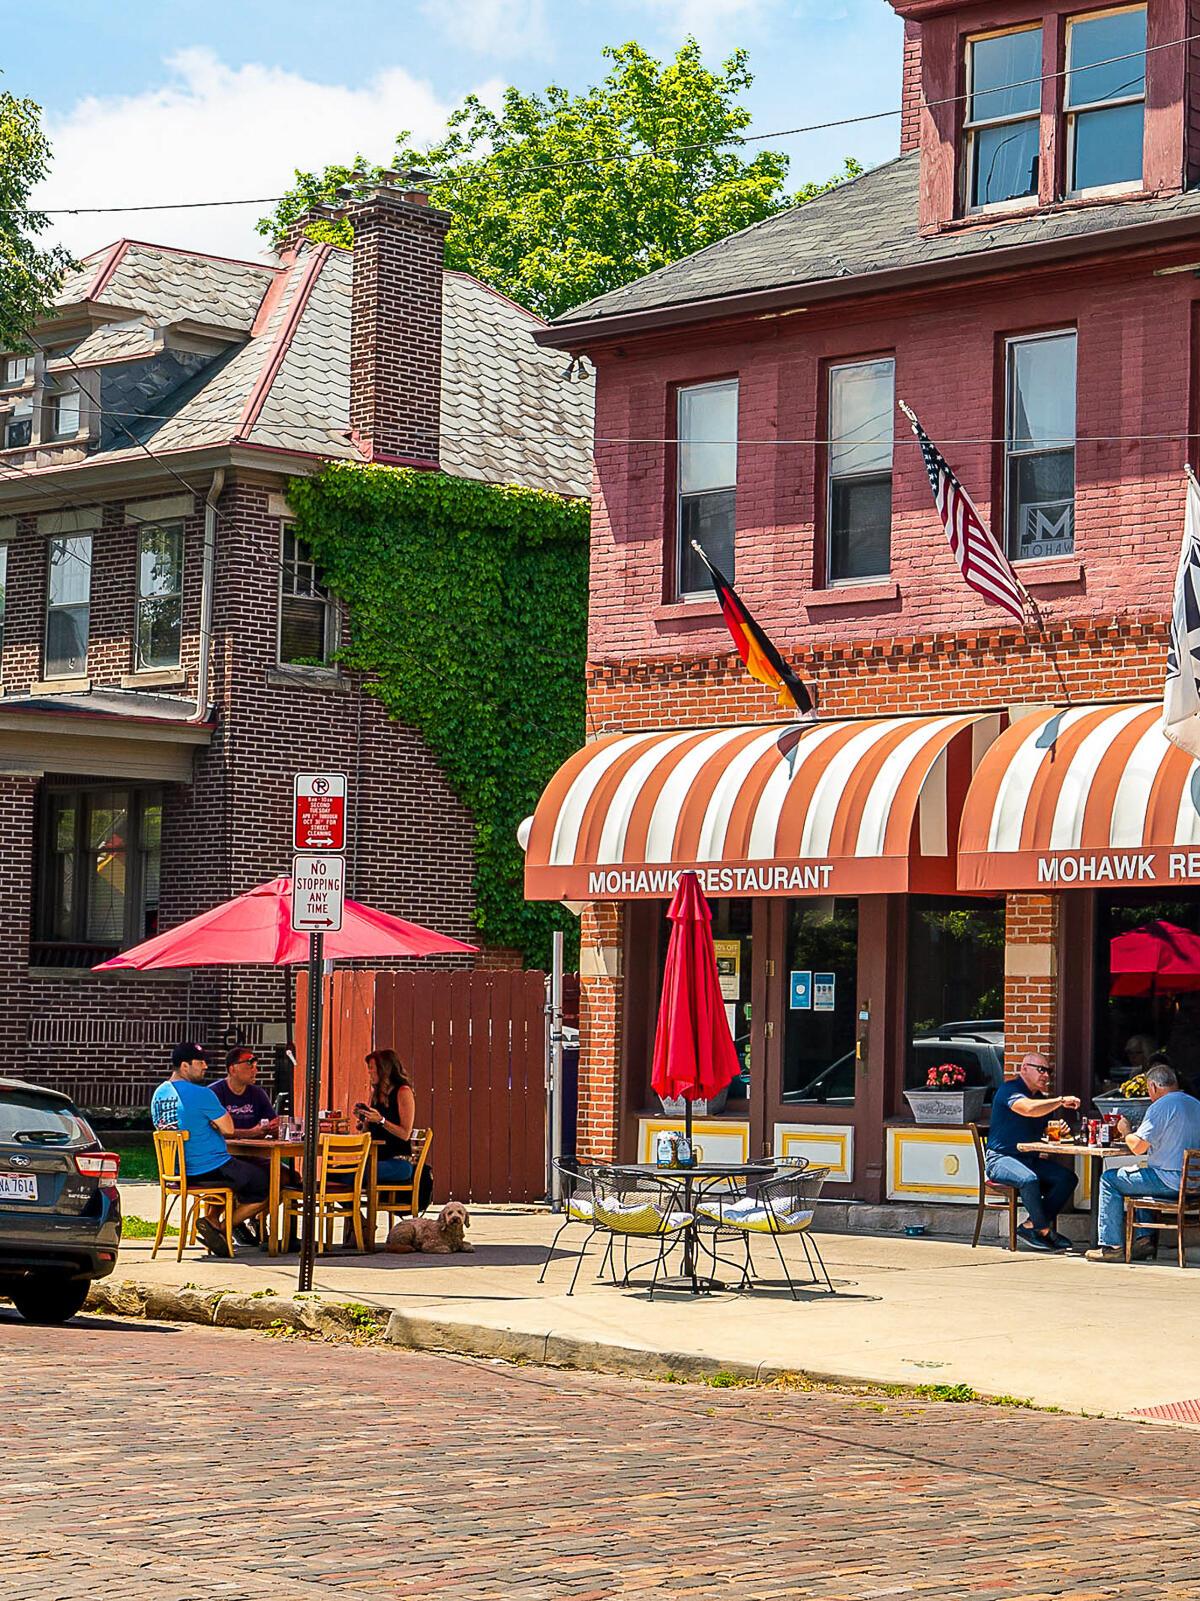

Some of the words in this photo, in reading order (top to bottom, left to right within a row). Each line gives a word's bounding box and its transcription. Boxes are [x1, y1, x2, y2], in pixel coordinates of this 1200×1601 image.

[310, 863, 327, 875] NO
[1037, 854, 1156, 882] MOHAWK
[297, 877, 340, 891] STOPPING
[588, 870, 682, 894] MOHAWK
[694, 865, 834, 892] RESTAURANT
[309, 892, 328, 902] ANY
[306, 903, 329, 914] TIME
[12, 1179, 34, 1192] 7614
